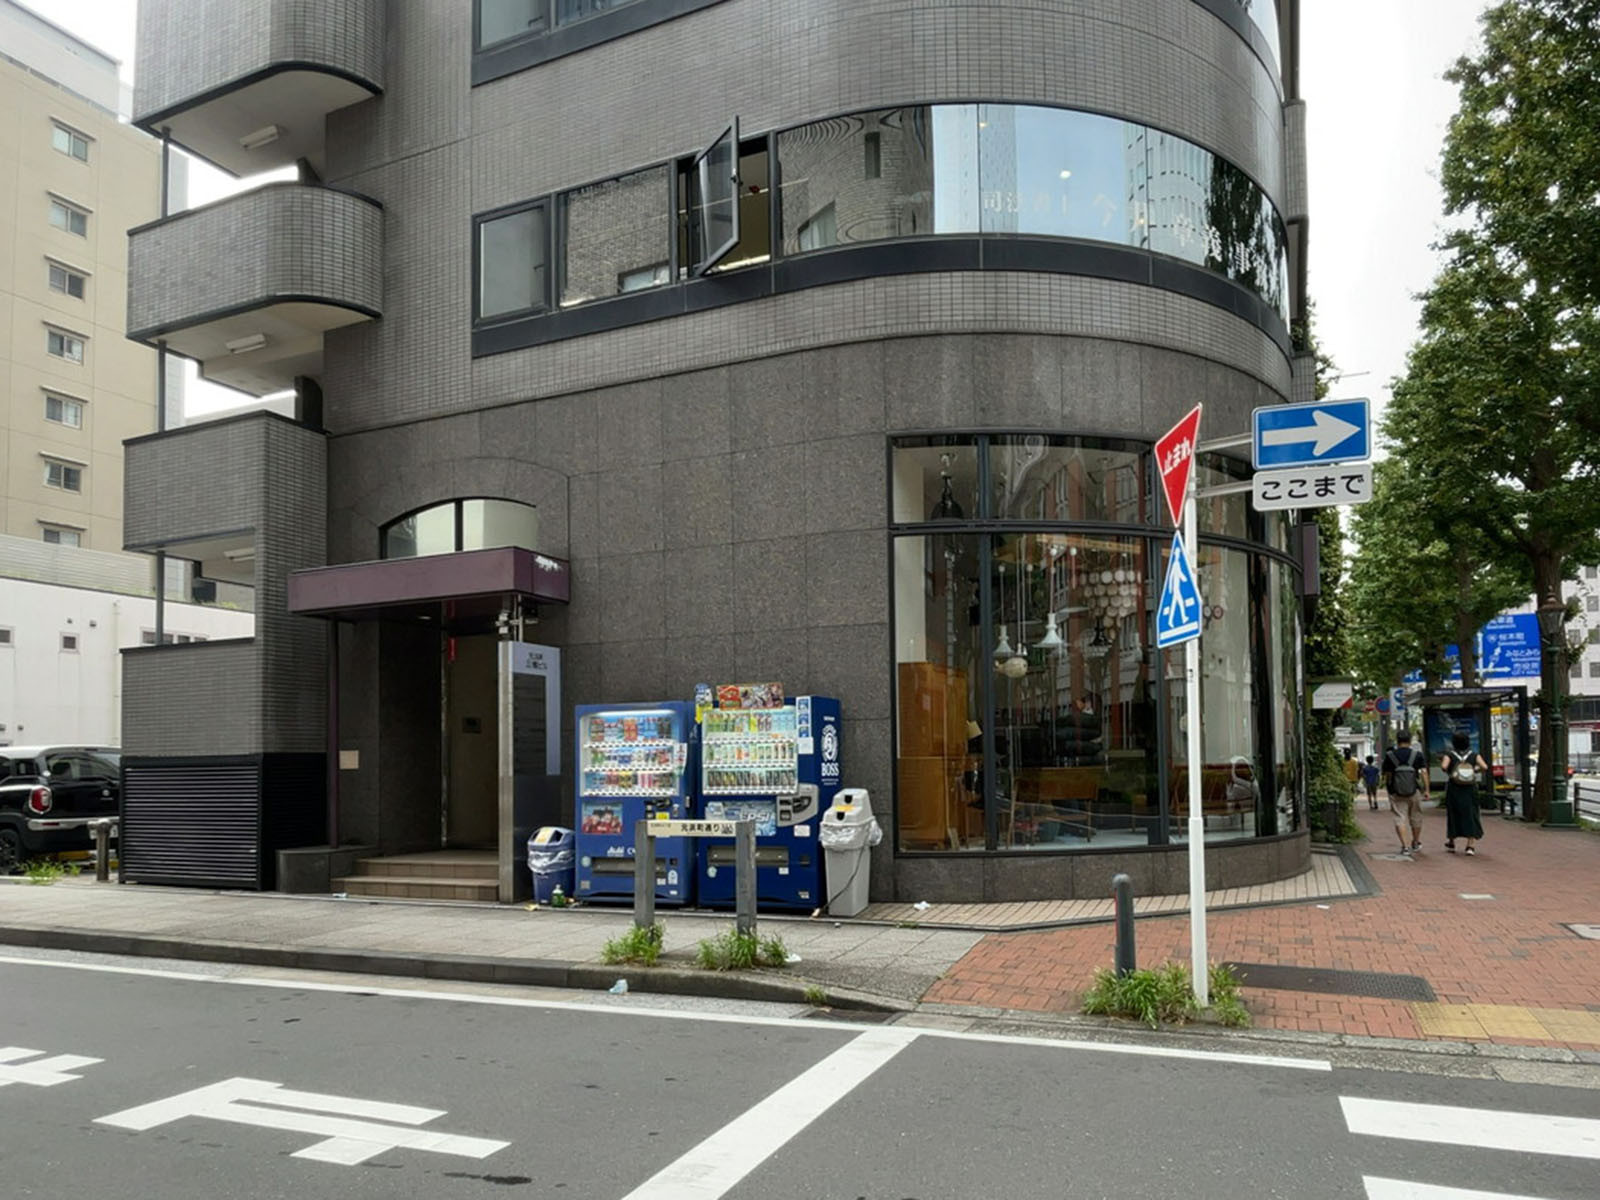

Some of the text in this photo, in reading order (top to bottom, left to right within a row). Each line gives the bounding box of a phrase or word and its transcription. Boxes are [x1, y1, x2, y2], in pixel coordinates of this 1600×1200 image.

[1164, 436, 1191, 476] 止まれ
[1261, 473, 1366, 502] ここまで
[821, 762, 839, 777] BOSS
